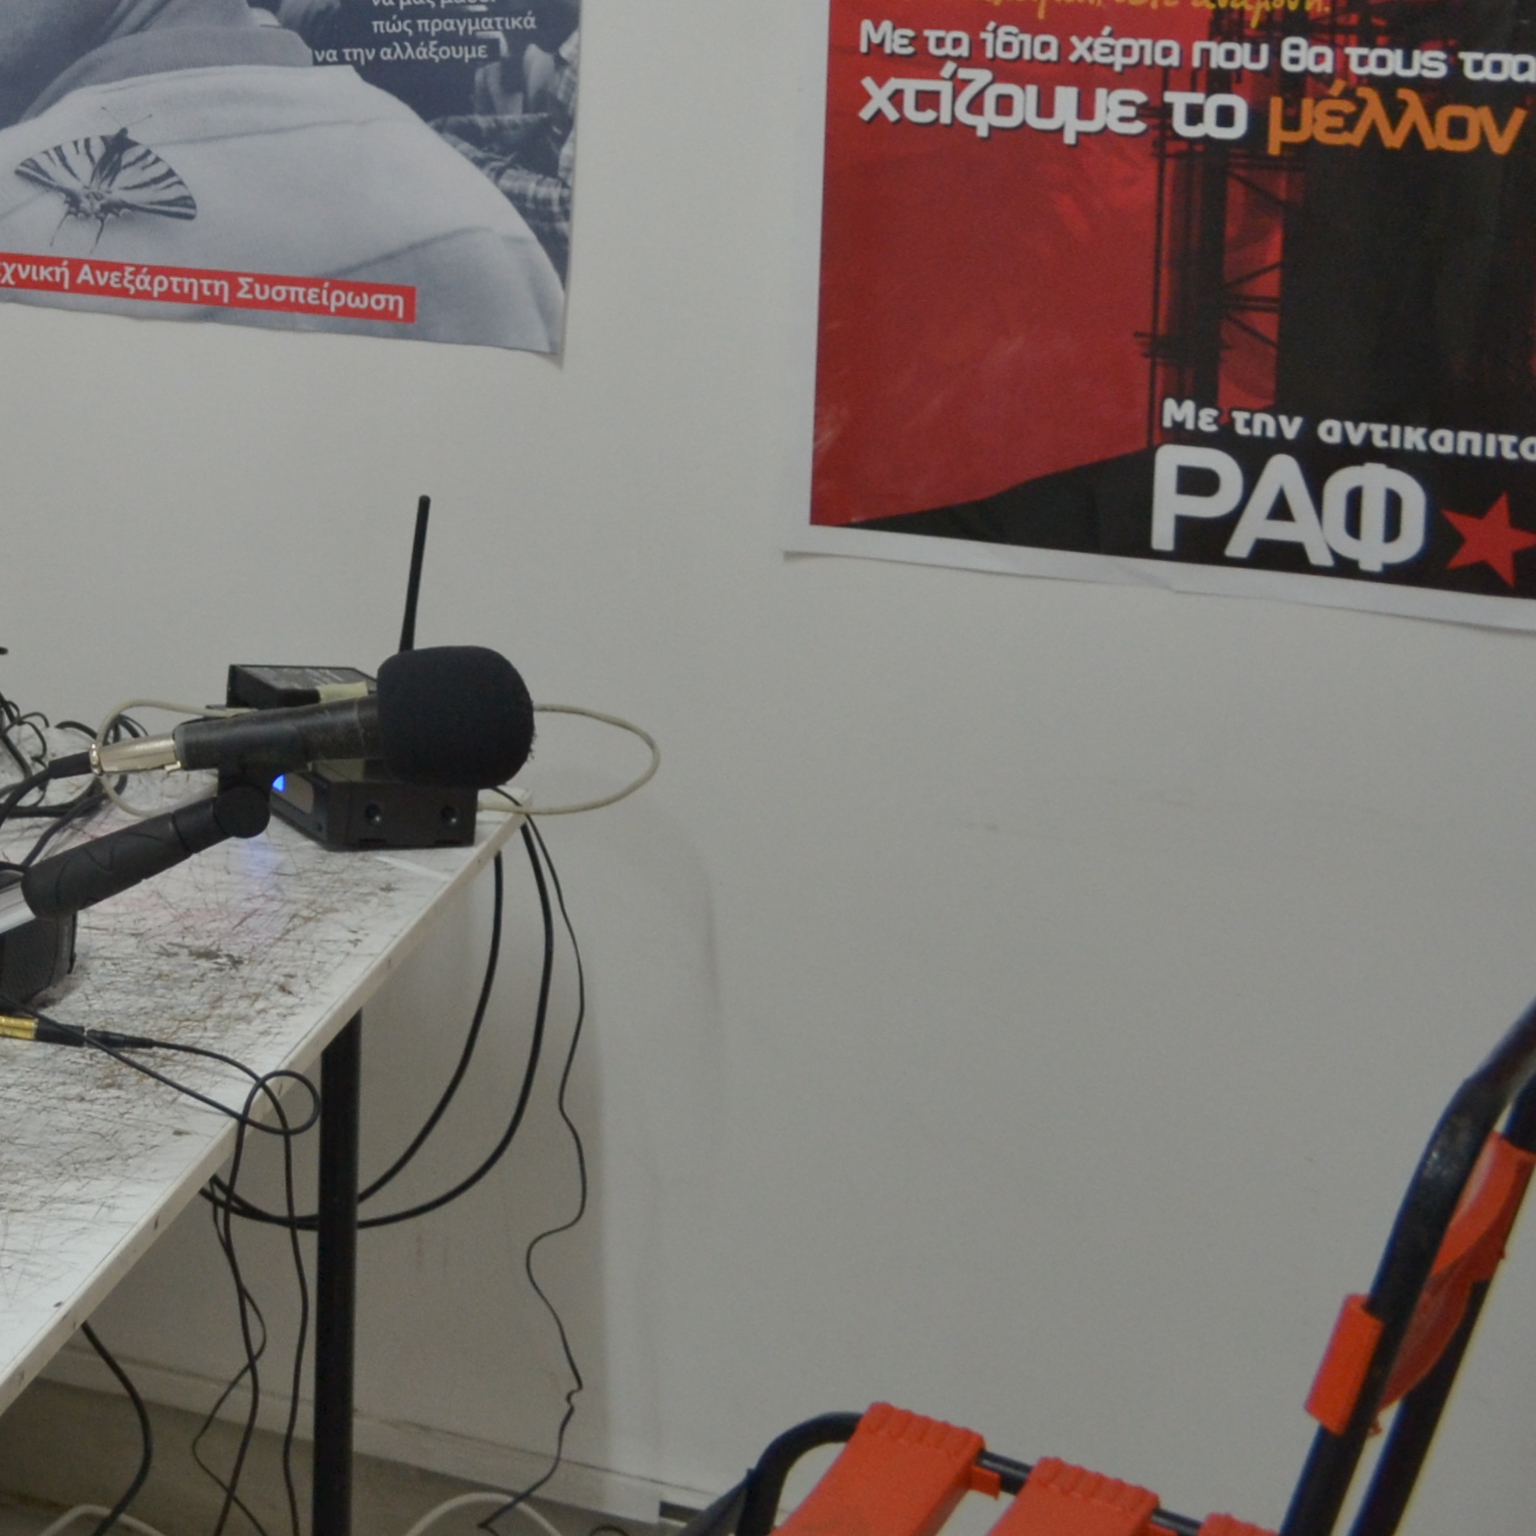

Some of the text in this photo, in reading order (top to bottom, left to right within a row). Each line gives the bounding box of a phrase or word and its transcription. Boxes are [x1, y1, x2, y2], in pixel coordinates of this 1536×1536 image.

[372, 9, 537, 35] πώς πραγματικά
[860, 19, 916, 55] Με
[923, 29, 970, 58] τα
[980, 21, 1059, 61] ίδια
[1068, 25, 1181, 72] χέρια
[1192, 39, 1269, 71] που
[1281, 37, 1333, 74] θα
[1345, 46, 1447, 79] τους
[314, 41, 488, 65] να την αλλάξουμε
[858, 61, 1527, 156] χτίζουμε το μέλλον
[77, 263, 229, 303] Ανεξάρτητη
[236, 276, 405, 319] Συσπείρωση
[1162, 397, 1304, 440] Με την
[1151, 443, 1428, 572] ΡΑΦ
